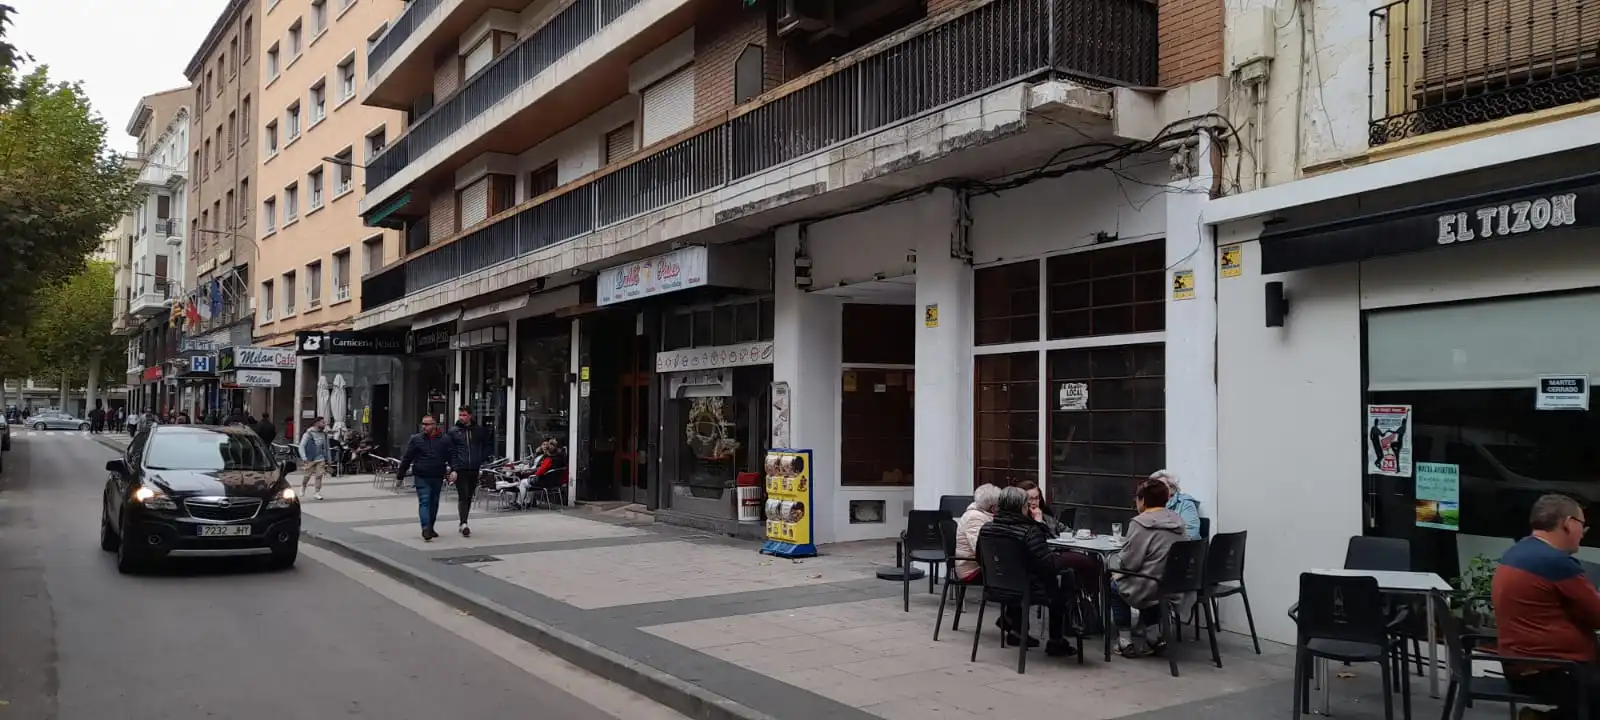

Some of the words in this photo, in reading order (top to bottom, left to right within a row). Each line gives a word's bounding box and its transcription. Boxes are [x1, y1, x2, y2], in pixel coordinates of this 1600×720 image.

[1438, 212, 1475, 244] EL
[1476, 193, 1577, 238] TIZON
[240, 350, 275, 364] Milan
[275, 352, 296, 367] Café
[245, 375, 272, 383] Milan
[204, 526, 228, 535] 7232
